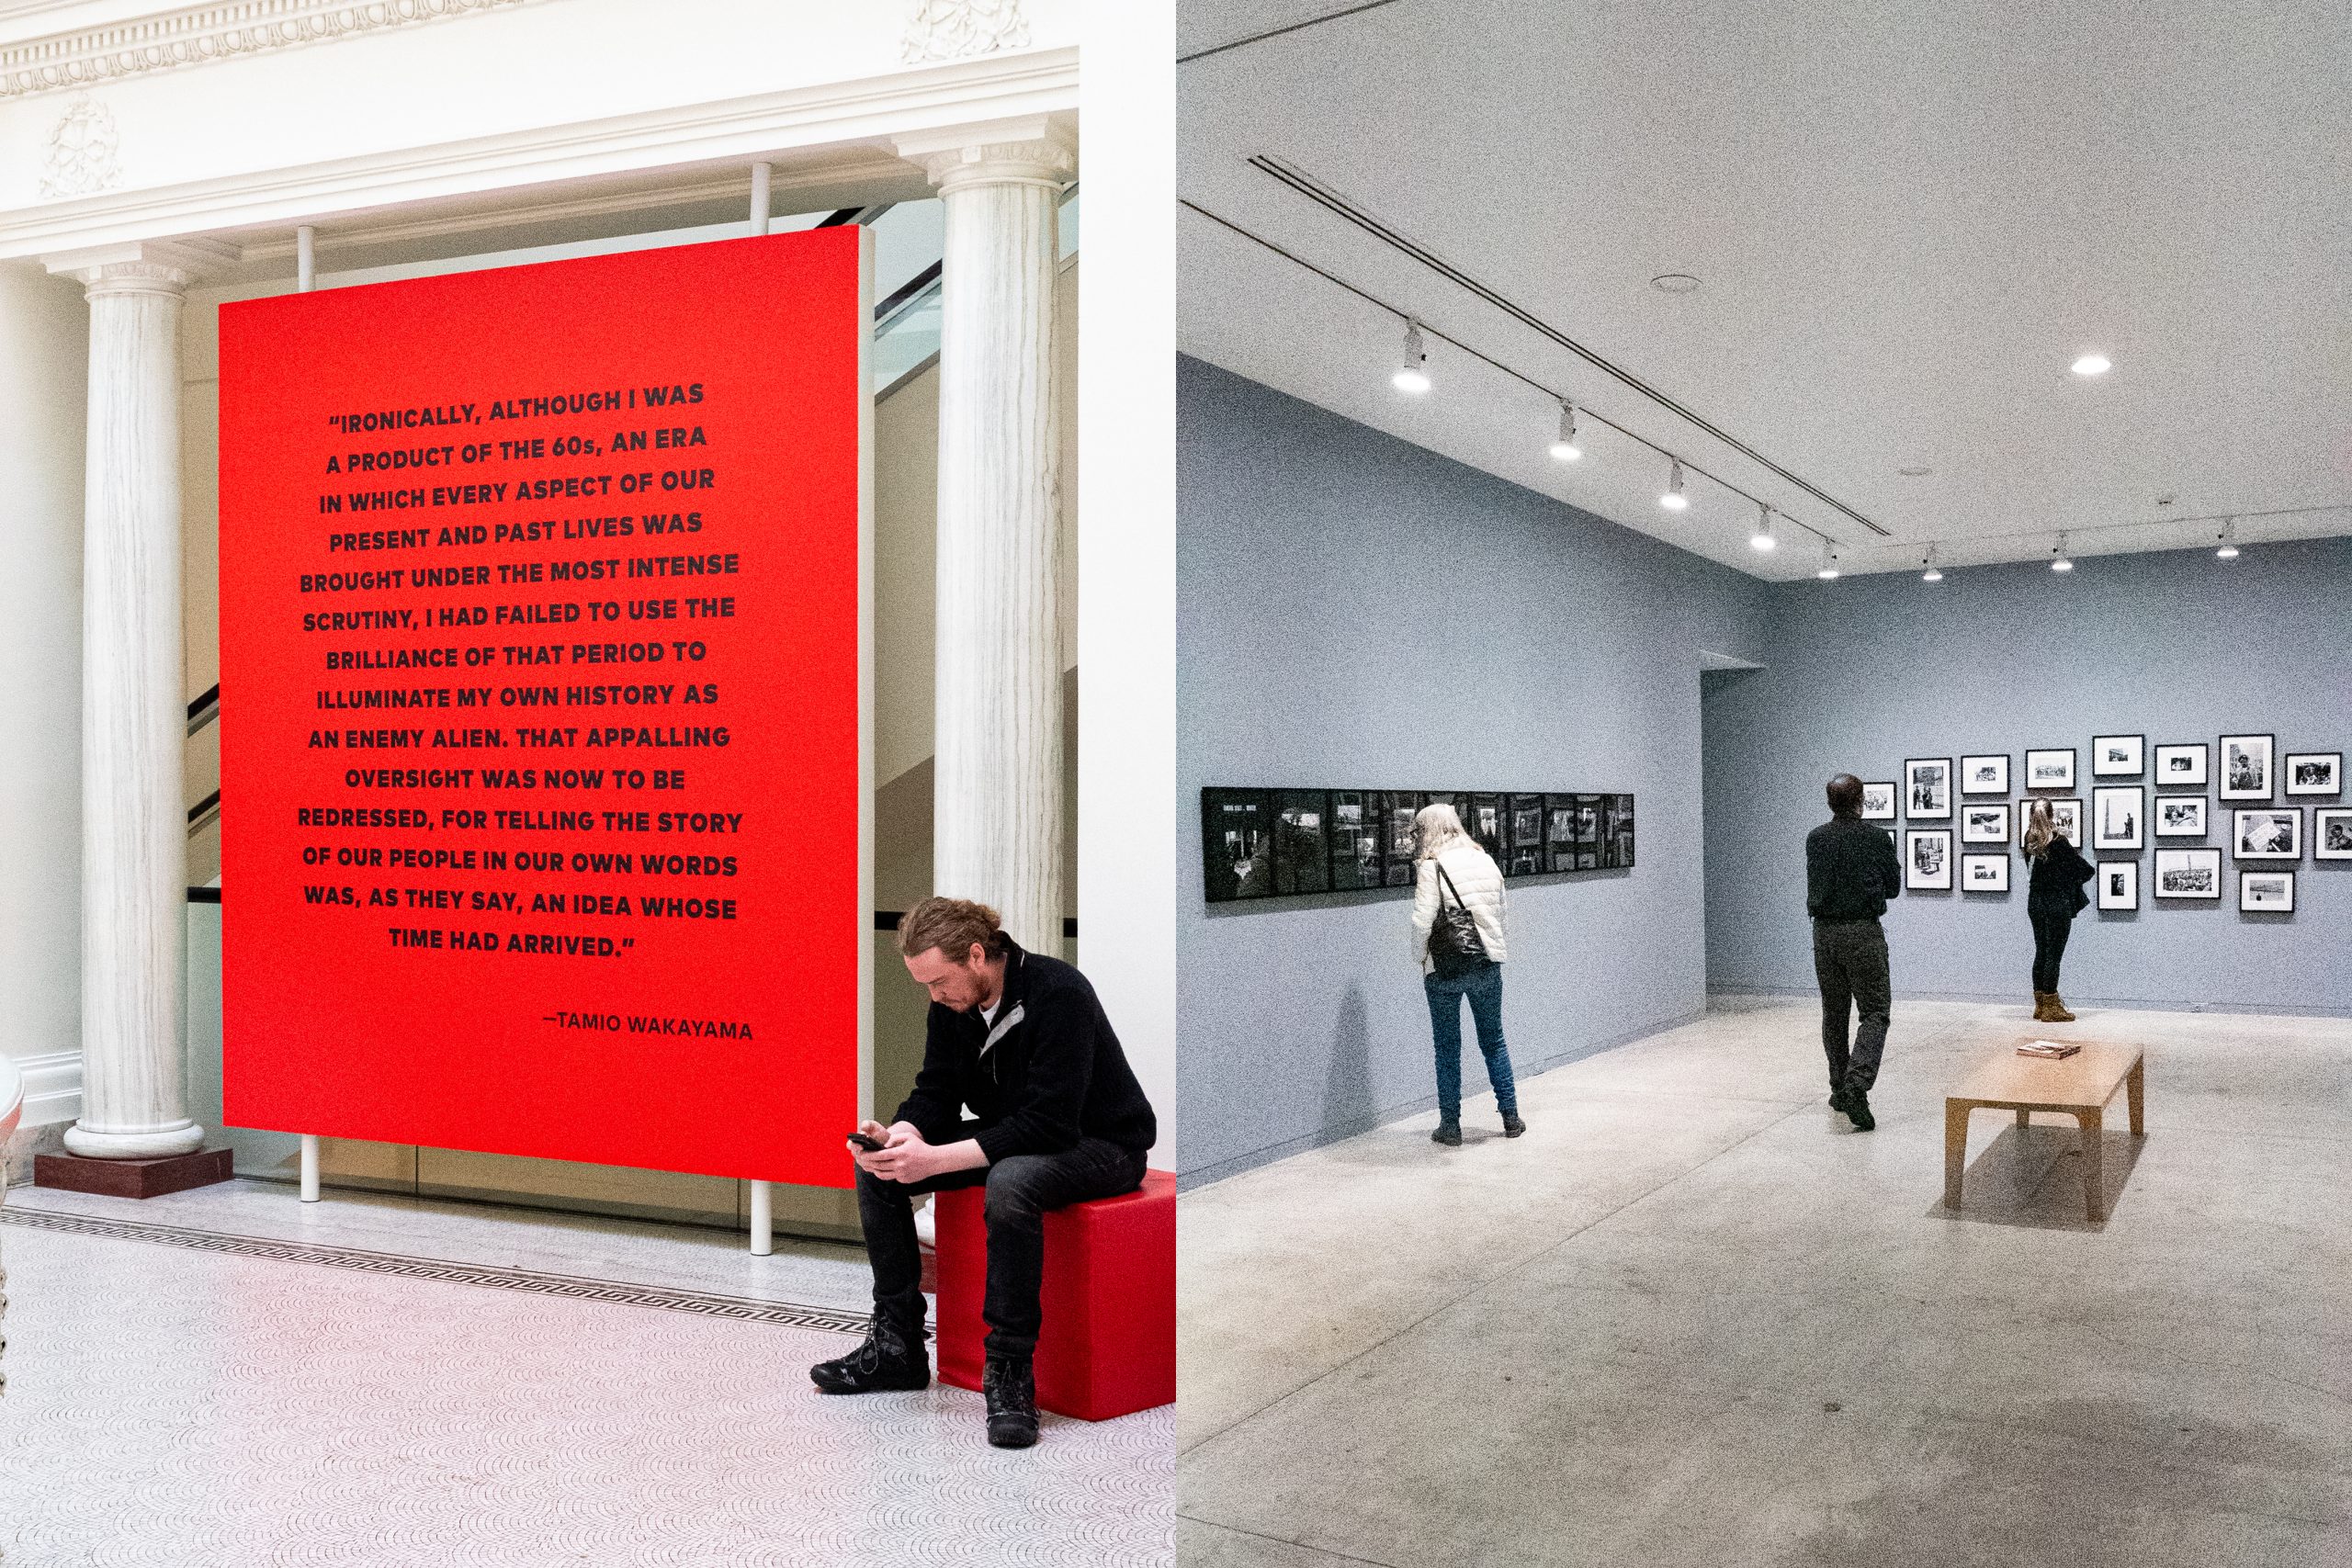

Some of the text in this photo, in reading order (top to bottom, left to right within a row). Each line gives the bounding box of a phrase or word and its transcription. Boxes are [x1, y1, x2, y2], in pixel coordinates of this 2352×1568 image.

[489, 390, 621, 421] ALTHOUGH
[628, 389, 635, 409] I
[643, 383, 704, 407] WAS
[326, 426, 707, 474] A PRODUCT OF THE 60s, AN ERA
[320, 468, 715, 513] IN WHICH EVERY ASPECT OF OUR
[330, 512, 702, 552] PRESENT AND PAST LIVES WAS
[300, 553, 739, 593] BROUGHT UNDER THE MOST INTENSE
[303, 597, 735, 632] SCRUTINY, I HAD FAILED TO USE THE
[326, 640, 707, 671] BRILLIANCE OF THAT PERIOD TO
[317, 683, 718, 709] ILLUMINATE MY OWN HISTORY AS
[308, 727, 730, 749] AN ENEMY ALIEN. THAT APPALLING
[345, 769, 684, 790] OVERSIGHT WAS NOW TO BE
[298, 807, 743, 833] REDRESSED, FOR TELLING THE STORY
[302, 846, 738, 877] OF OUR PEOPLE IN OUR OWN WORDS
[303, 886, 737, 920] WAS, AS THEY SAY, AN IDEA WHOSE
[388, 928, 443, 949] TIME
[449, 931, 500, 952] HAD
[628, 1016, 752, 1040] WAKAYAMA
